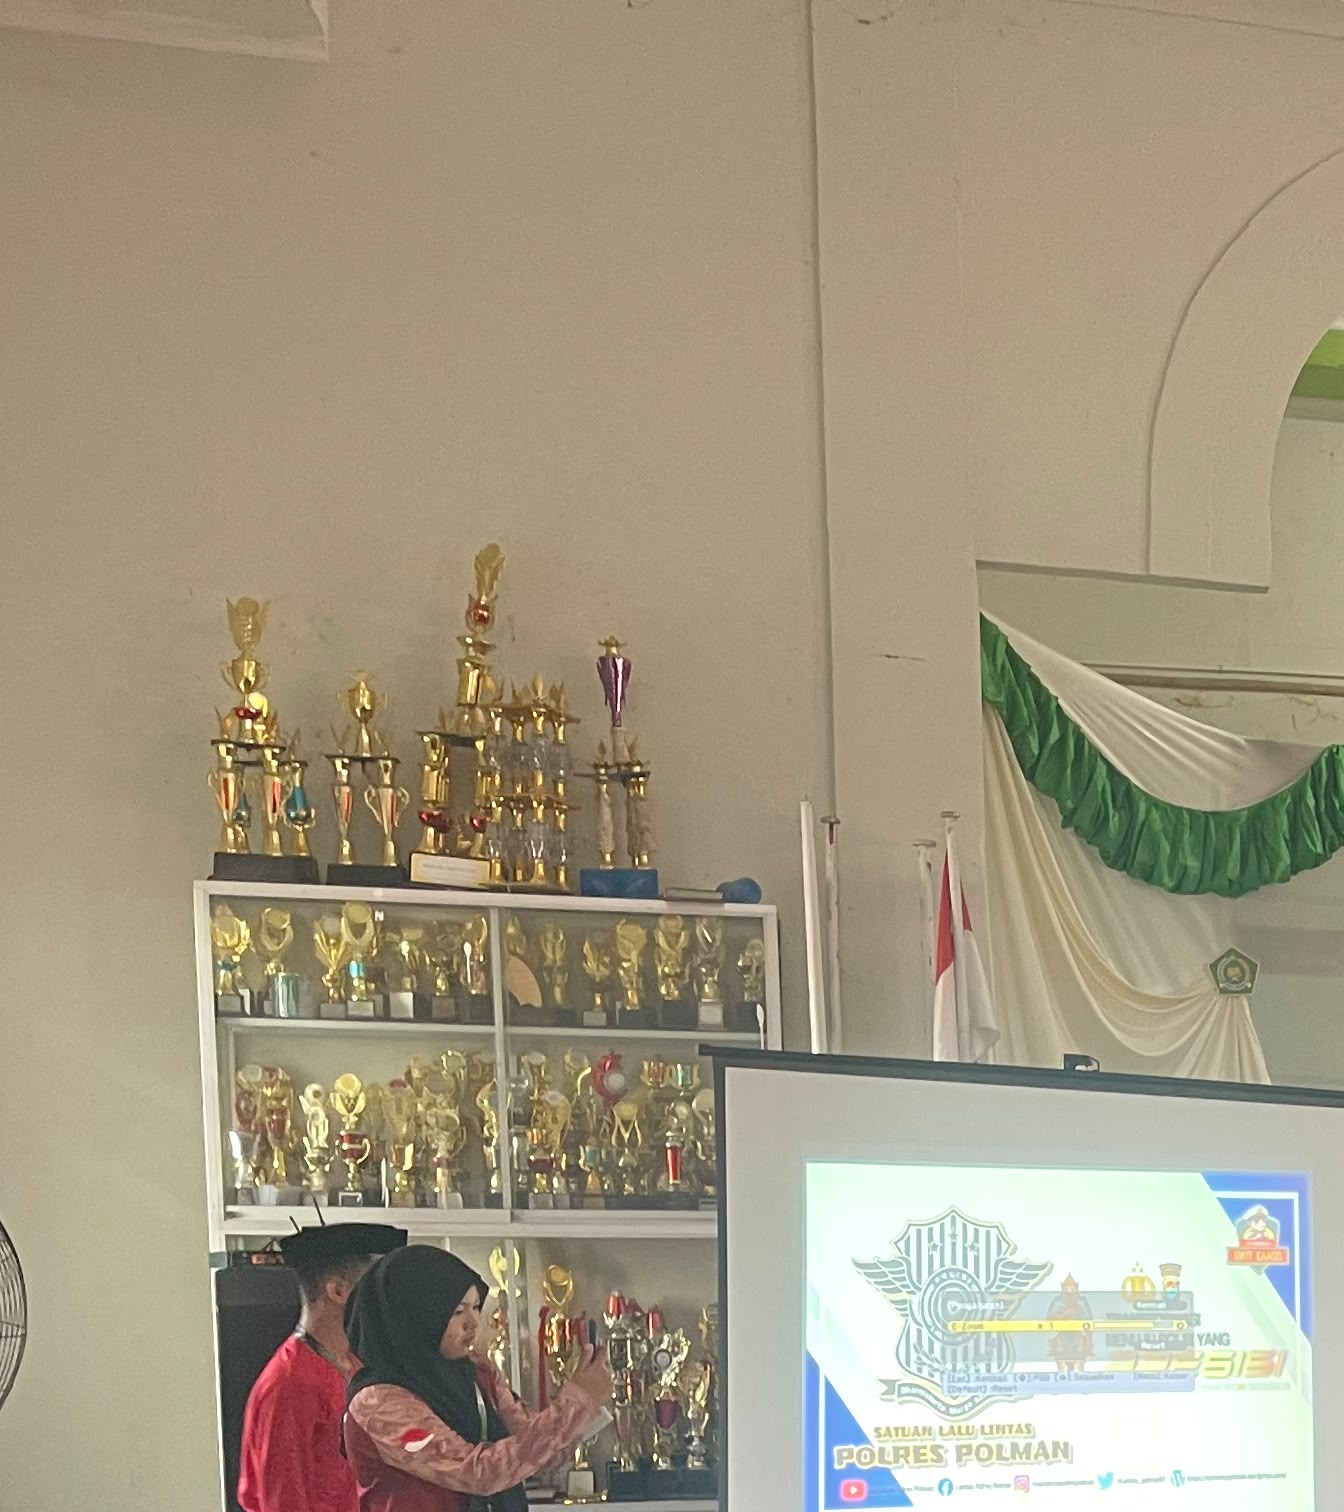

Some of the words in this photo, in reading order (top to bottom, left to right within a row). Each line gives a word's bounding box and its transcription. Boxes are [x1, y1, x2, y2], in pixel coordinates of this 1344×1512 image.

[1197, 1332, 1231, 1347] YANG
[873, 1425, 933, 1439] SATUAN
[938, 1424, 975, 1438] LALU
[980, 1423, 1033, 1437] LINTAS
[836, 1444, 946, 1467] POLRES
[955, 1440, 1070, 1465] POLMAN
